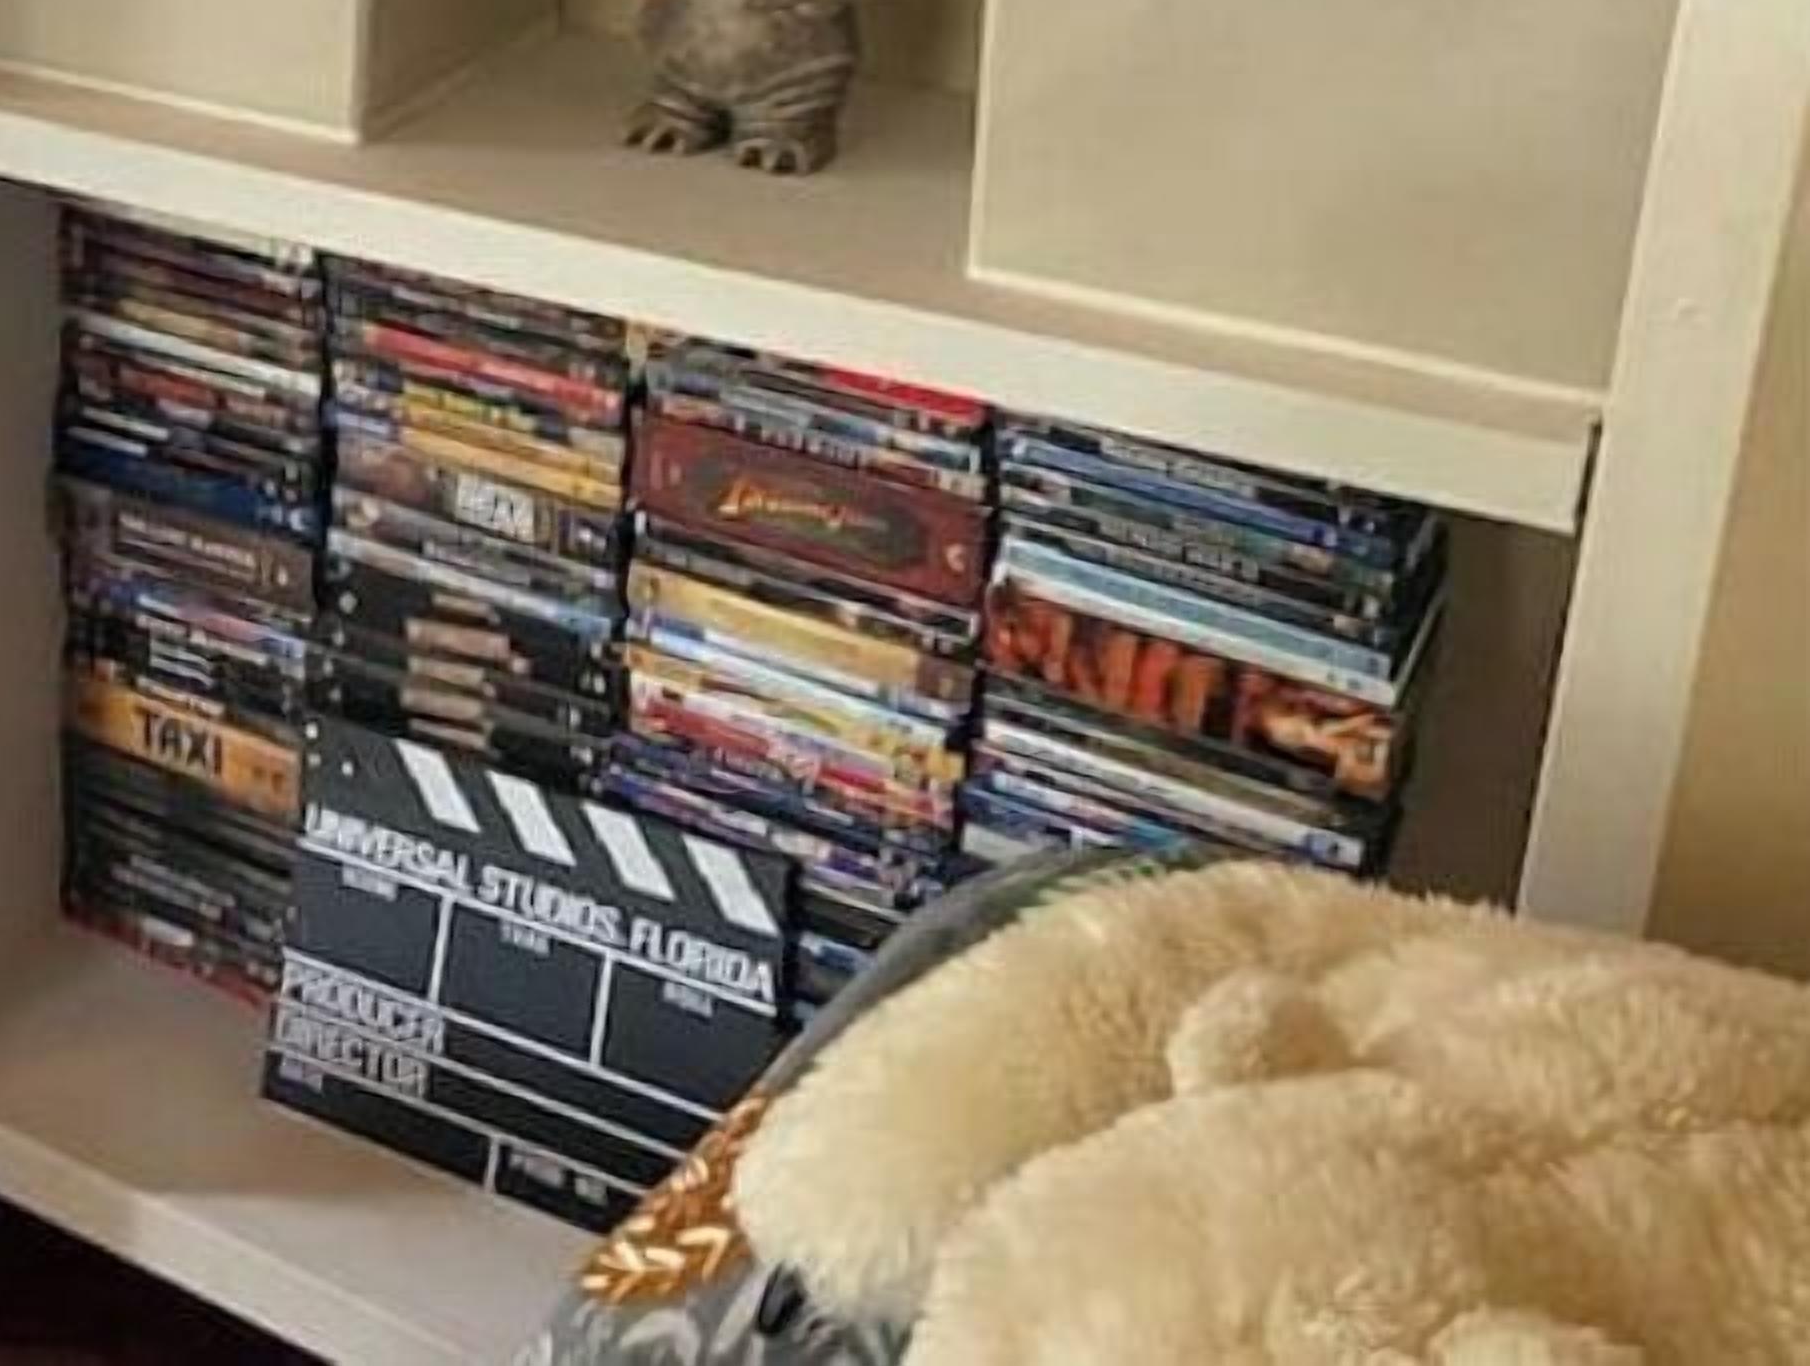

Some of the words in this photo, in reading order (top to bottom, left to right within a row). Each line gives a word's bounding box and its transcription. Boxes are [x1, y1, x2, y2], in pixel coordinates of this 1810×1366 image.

[136, 708, 223, 778] TAXI
[304, 802, 472, 890] UNIVERSAL
[476, 862, 624, 944] STUDIOS
[629, 917, 777, 1002] FLORIDA
[282, 959, 446, 1055] PRODUCER
[280, 1012, 430, 1098] DIRECTOR
